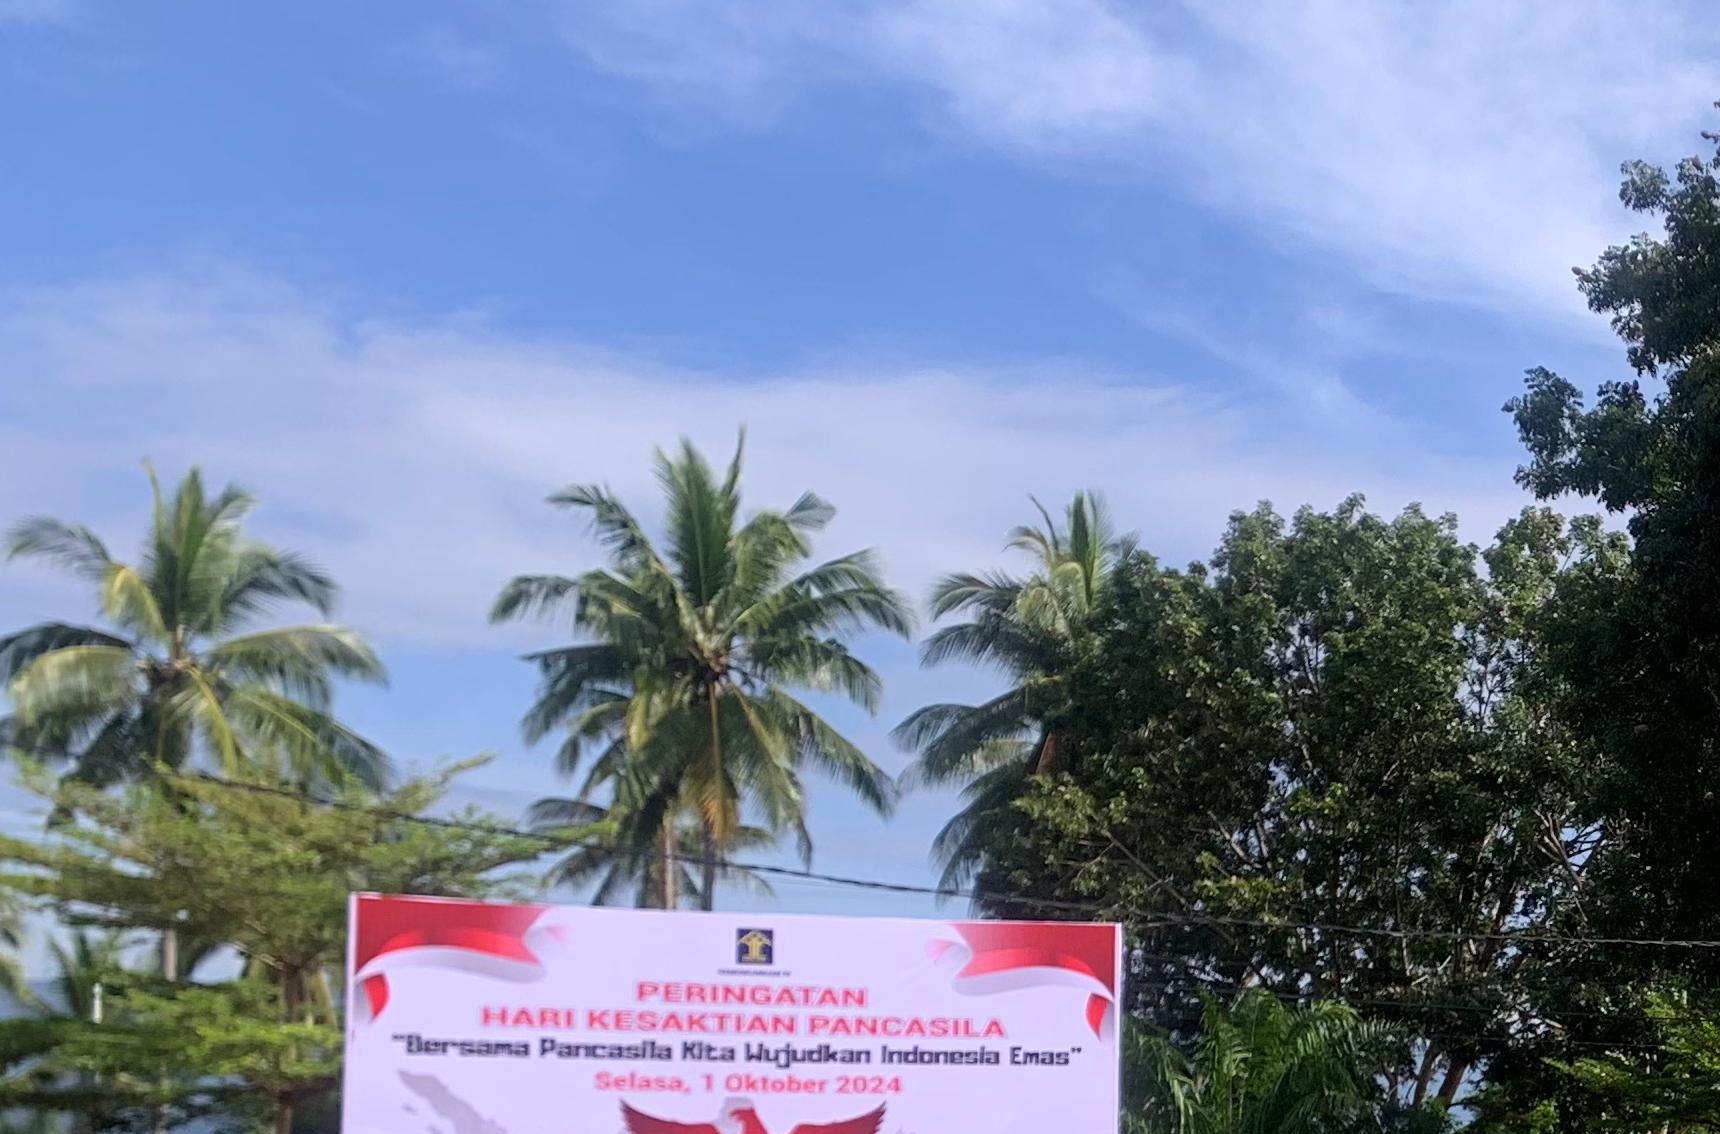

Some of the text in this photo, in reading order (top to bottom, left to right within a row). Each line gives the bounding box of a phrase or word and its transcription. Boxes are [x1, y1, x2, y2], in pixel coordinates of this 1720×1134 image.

[636, 981, 868, 1007] PERINGATAN
[481, 1006, 1007, 1038] HARI KESAKTIAN PANCASILA
[539, 1037, 672, 1061] Pancasila
[681, 1039, 735, 1061] Kita
[744, 1042, 870, 1069] Wujudkan
[880, 1044, 1000, 1065] Indonesia
[594, 1071, 902, 1094] Selasa, 1 Oktober 2024
